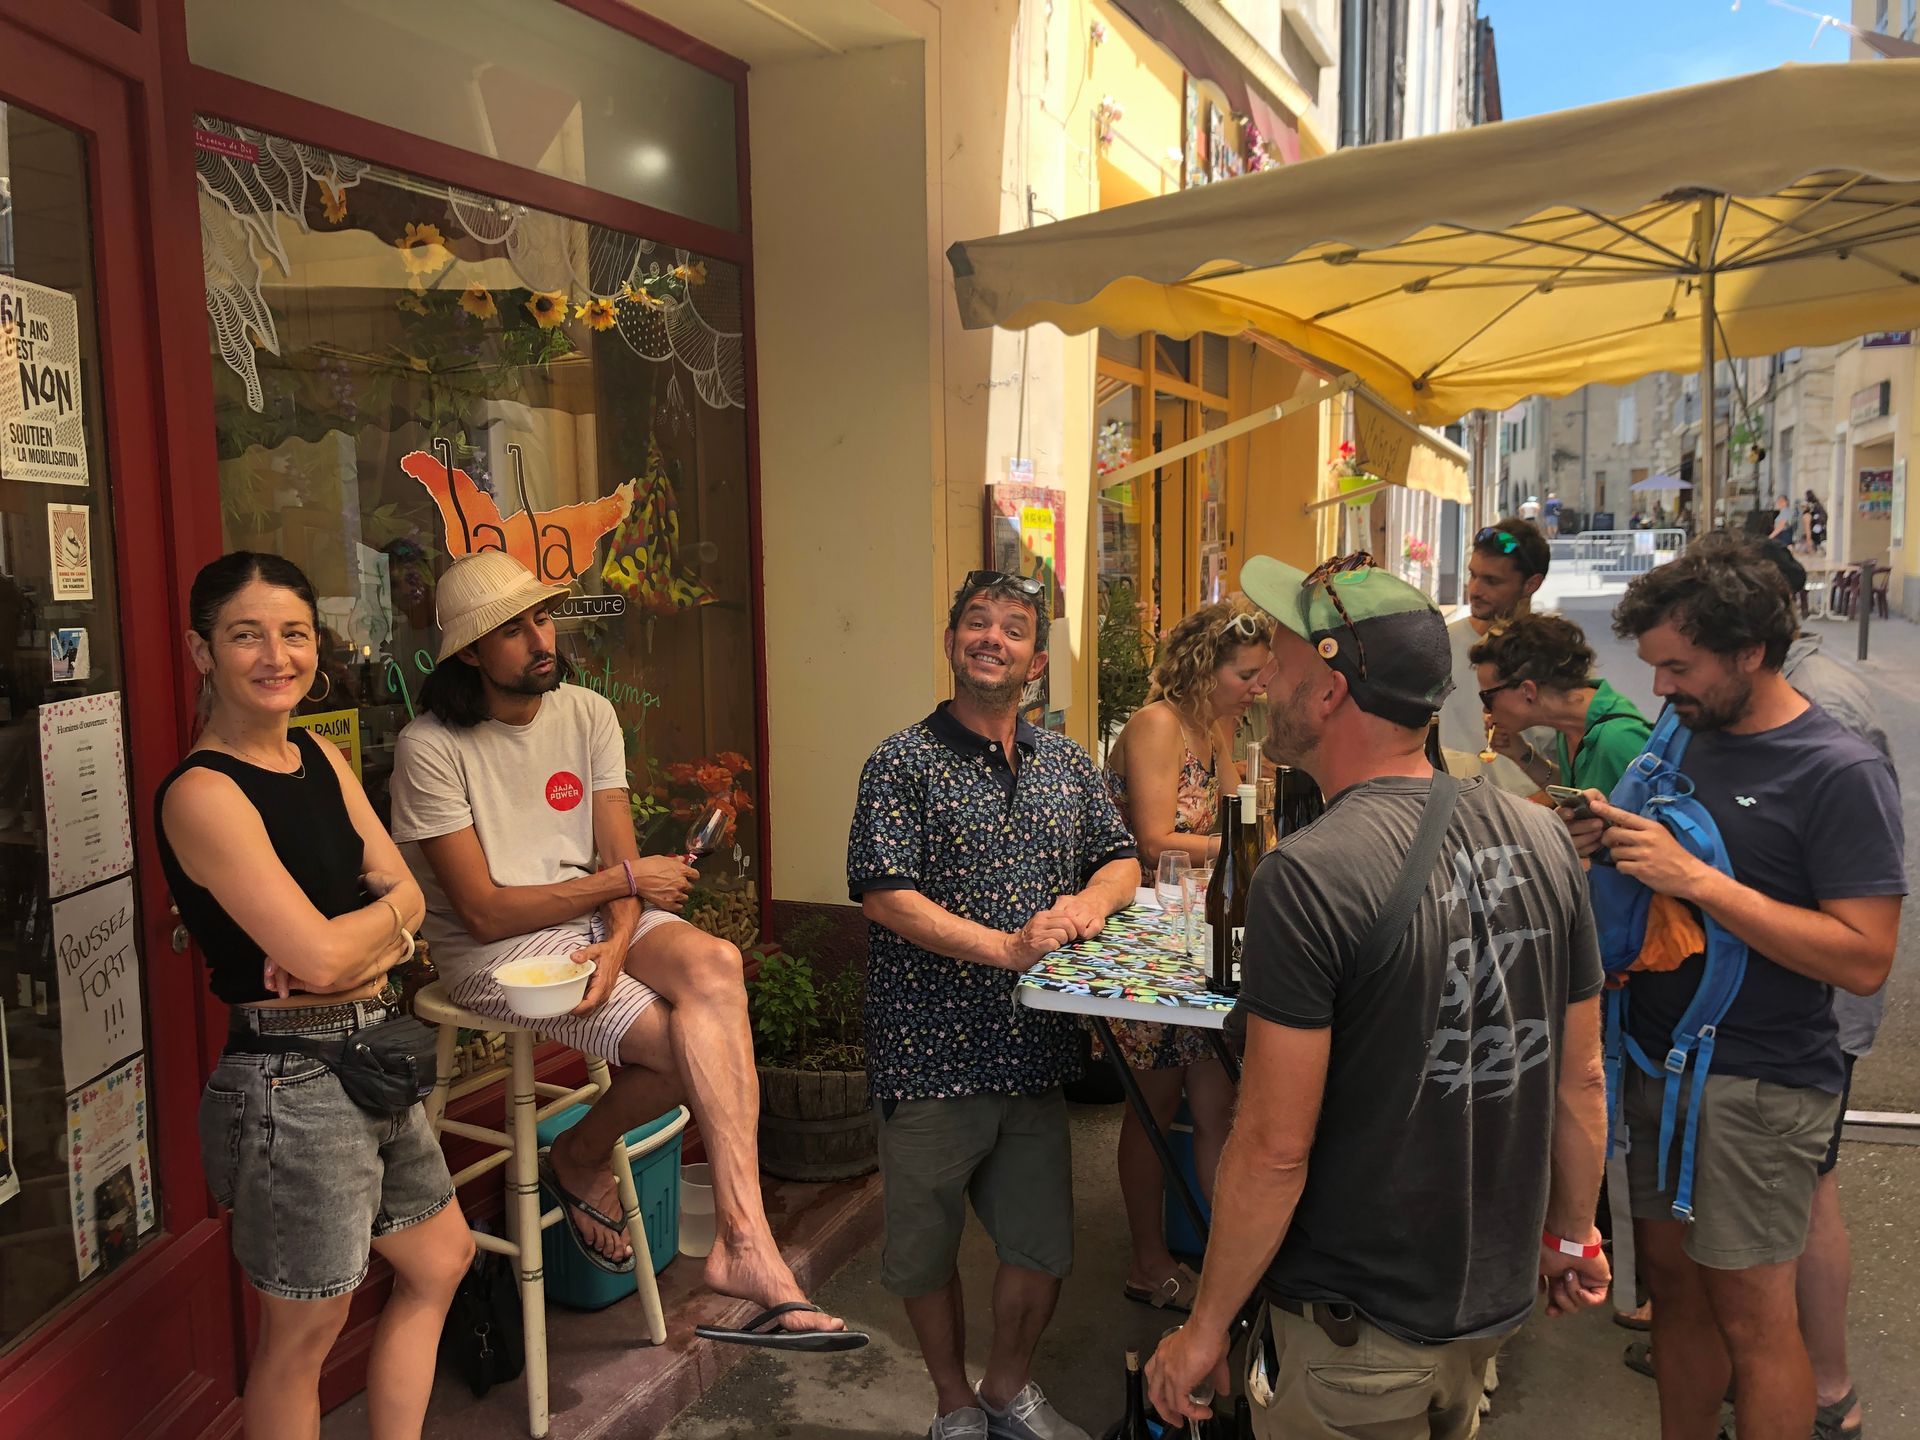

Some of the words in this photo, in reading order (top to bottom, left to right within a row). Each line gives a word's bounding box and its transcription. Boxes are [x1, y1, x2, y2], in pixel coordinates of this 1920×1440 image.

[1, 293, 26, 338] 64
[29, 319, 49, 342] ANS
[5, 336, 35, 361] C'EST
[19, 362, 73, 416] NON
[9, 422, 53, 447] SOUTIEN
[17, 447, 27, 463] LA
[28, 448, 79, 468] MOBILISATION
[314, 717, 351, 736] RAISIN
[550, 789, 579, 801] POWER
[552, 783, 574, 793] JAJA
[58, 906, 132, 976] POUSSEZ
[78, 944, 129, 1012] FORT
